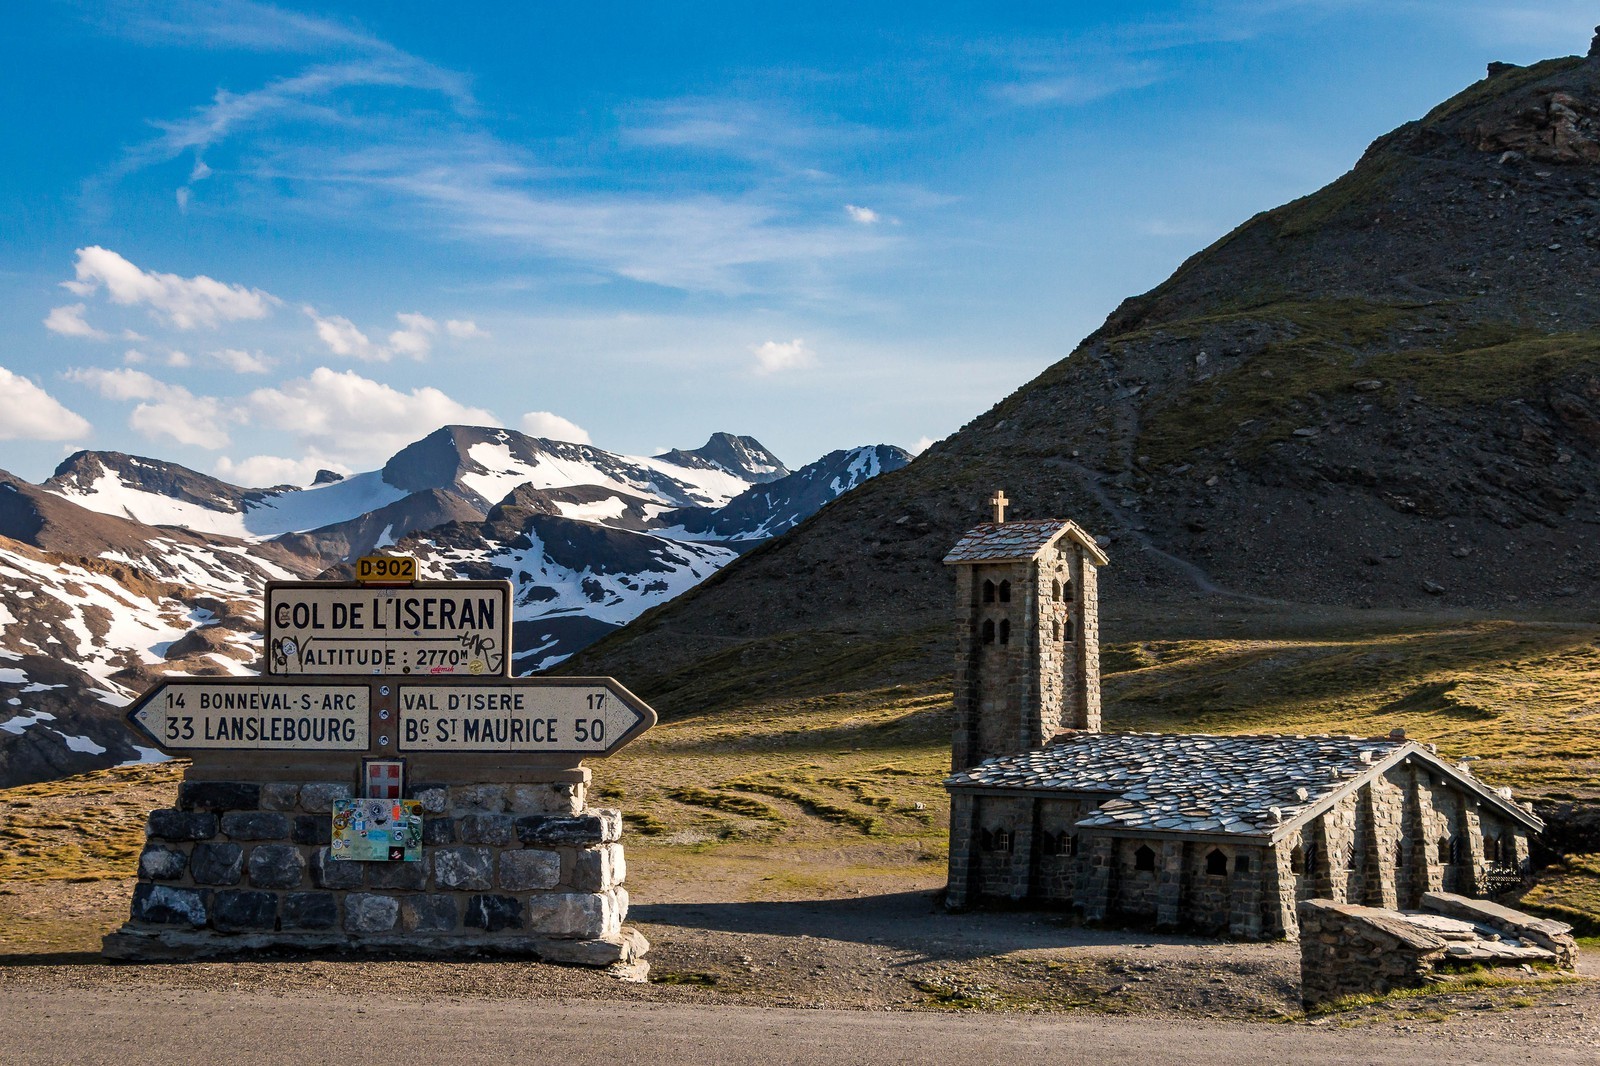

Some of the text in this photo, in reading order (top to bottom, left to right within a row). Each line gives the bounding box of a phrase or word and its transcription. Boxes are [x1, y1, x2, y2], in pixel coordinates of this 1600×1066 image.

[360, 559, 413, 576] D902
[274, 598, 495, 630] COL DE L'ISERAN
[304, 649, 396, 666] ALTITUDE
[166, 693, 356, 710] 14 BONNEVAL-S-ARC
[403, 694, 605, 711] VAL D'ISERE 17
[166, 717, 356, 742] 33 LANSLEBOURG
[463, 718, 558, 743] MAURICE
[574, 718, 605, 743] 50
